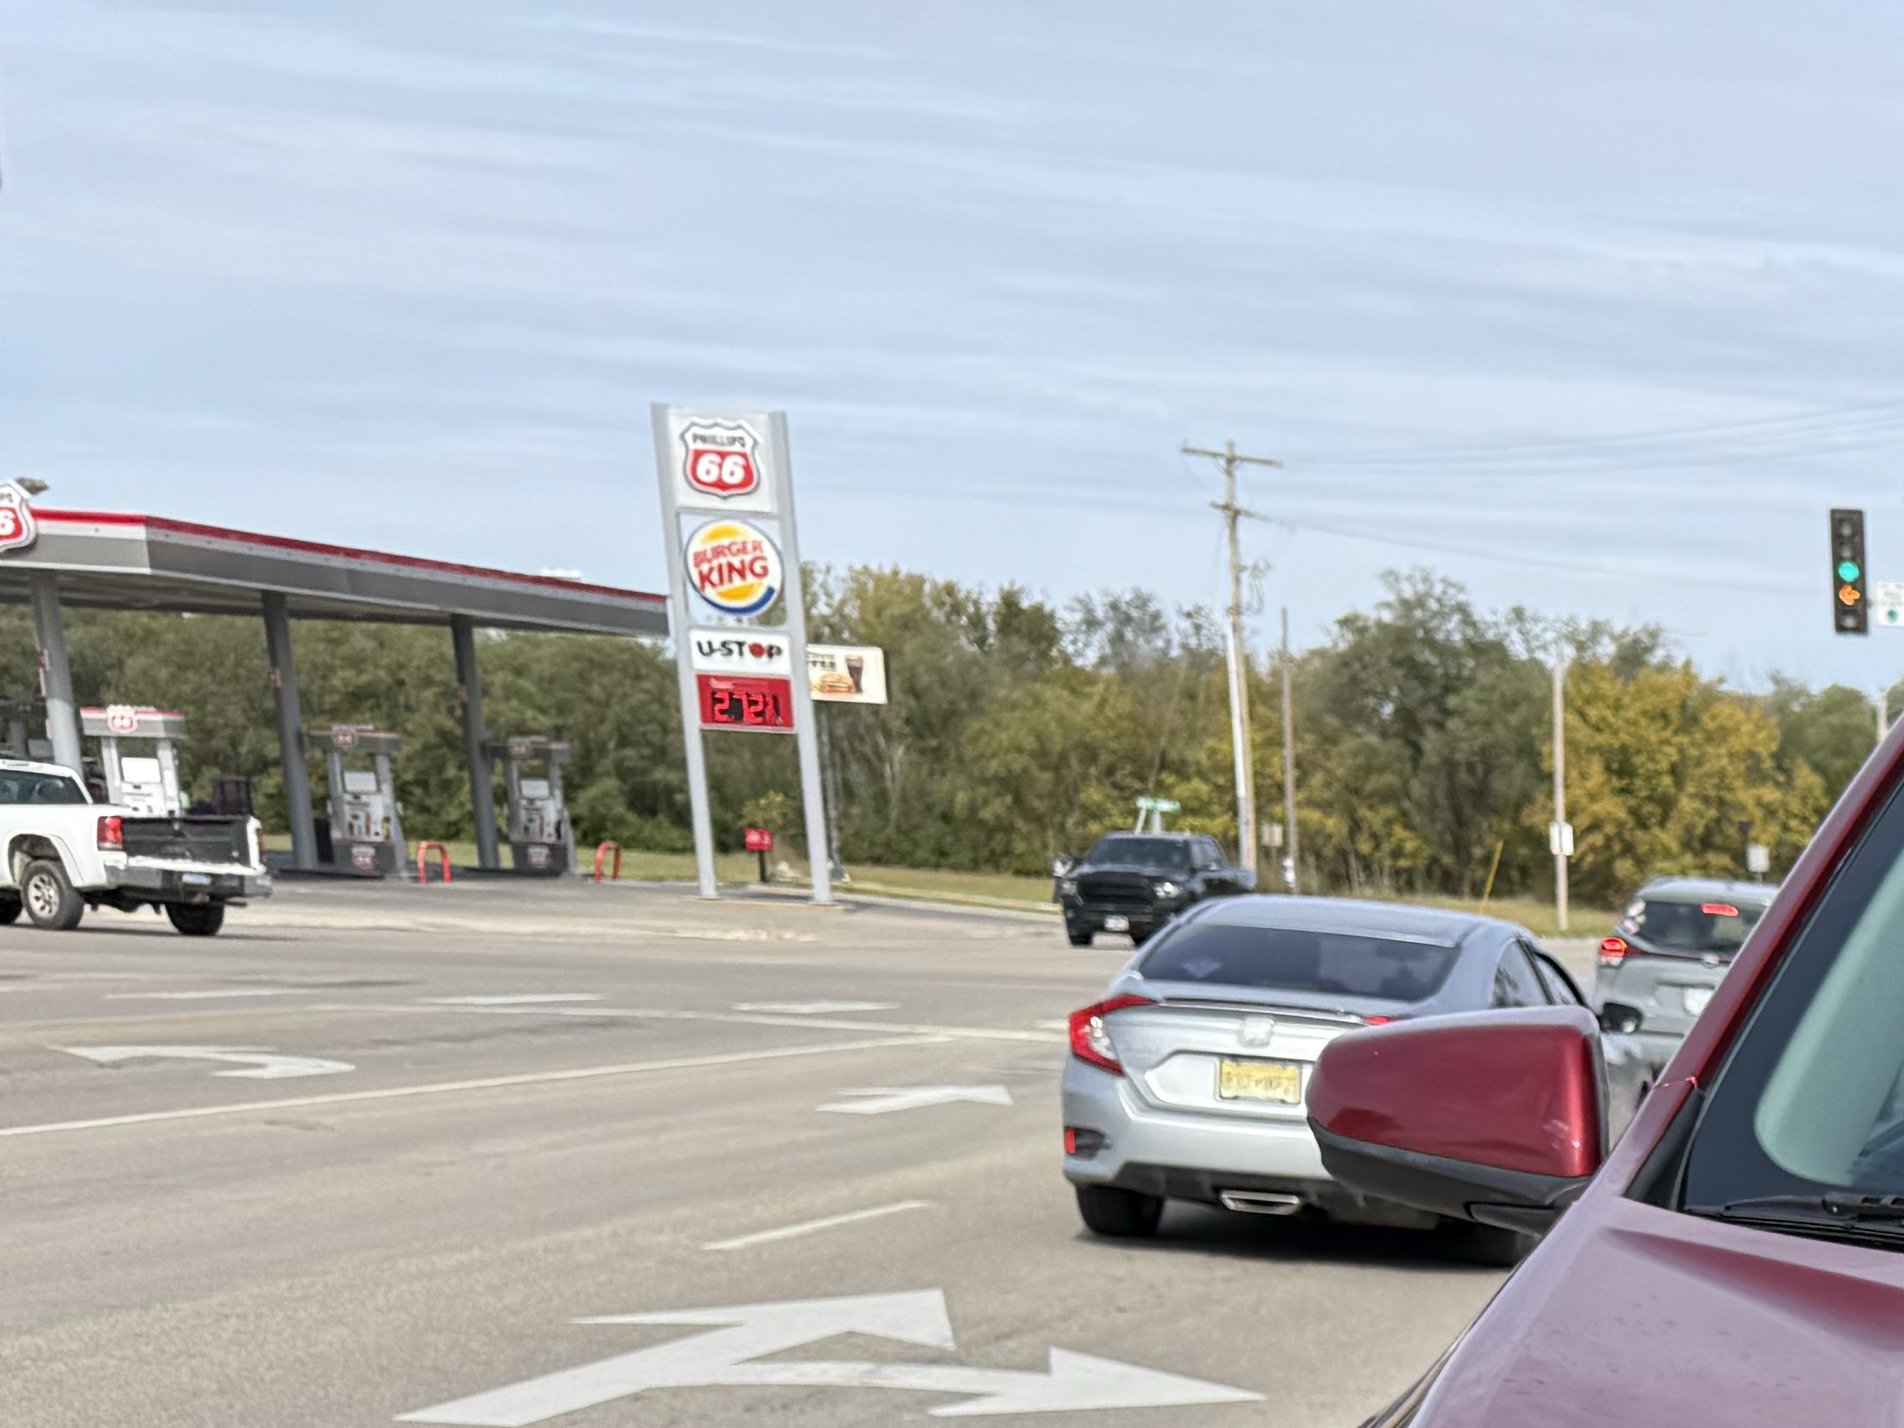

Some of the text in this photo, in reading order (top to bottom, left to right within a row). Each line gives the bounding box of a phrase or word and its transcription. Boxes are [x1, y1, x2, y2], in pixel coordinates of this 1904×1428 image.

[696, 452, 746, 485] 66
[693, 540, 764, 568] BURGER
[698, 556, 769, 592] KING
